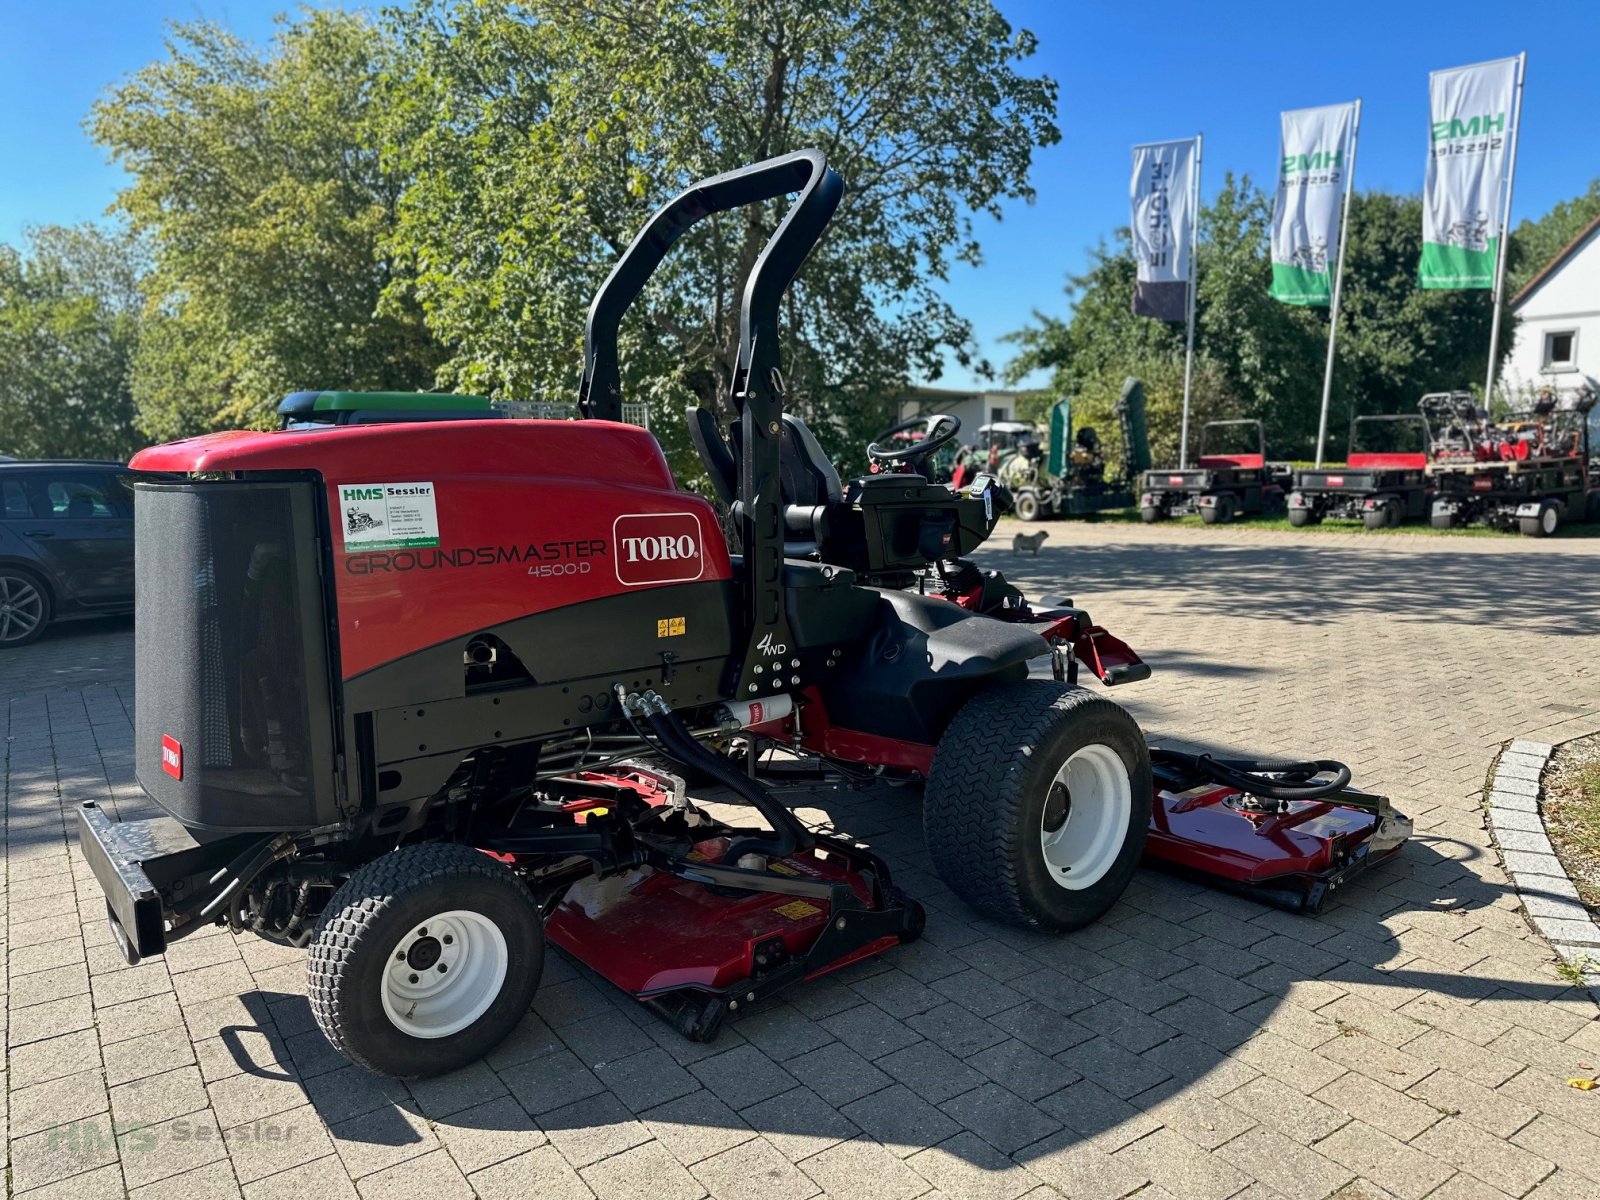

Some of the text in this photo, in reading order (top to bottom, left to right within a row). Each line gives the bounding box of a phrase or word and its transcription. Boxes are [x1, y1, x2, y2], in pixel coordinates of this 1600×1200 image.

[343, 487, 431, 501] HMS Sessler
[345, 539, 608, 575] GROUNDSMASTER
[757, 632, 786, 656] 4WD
